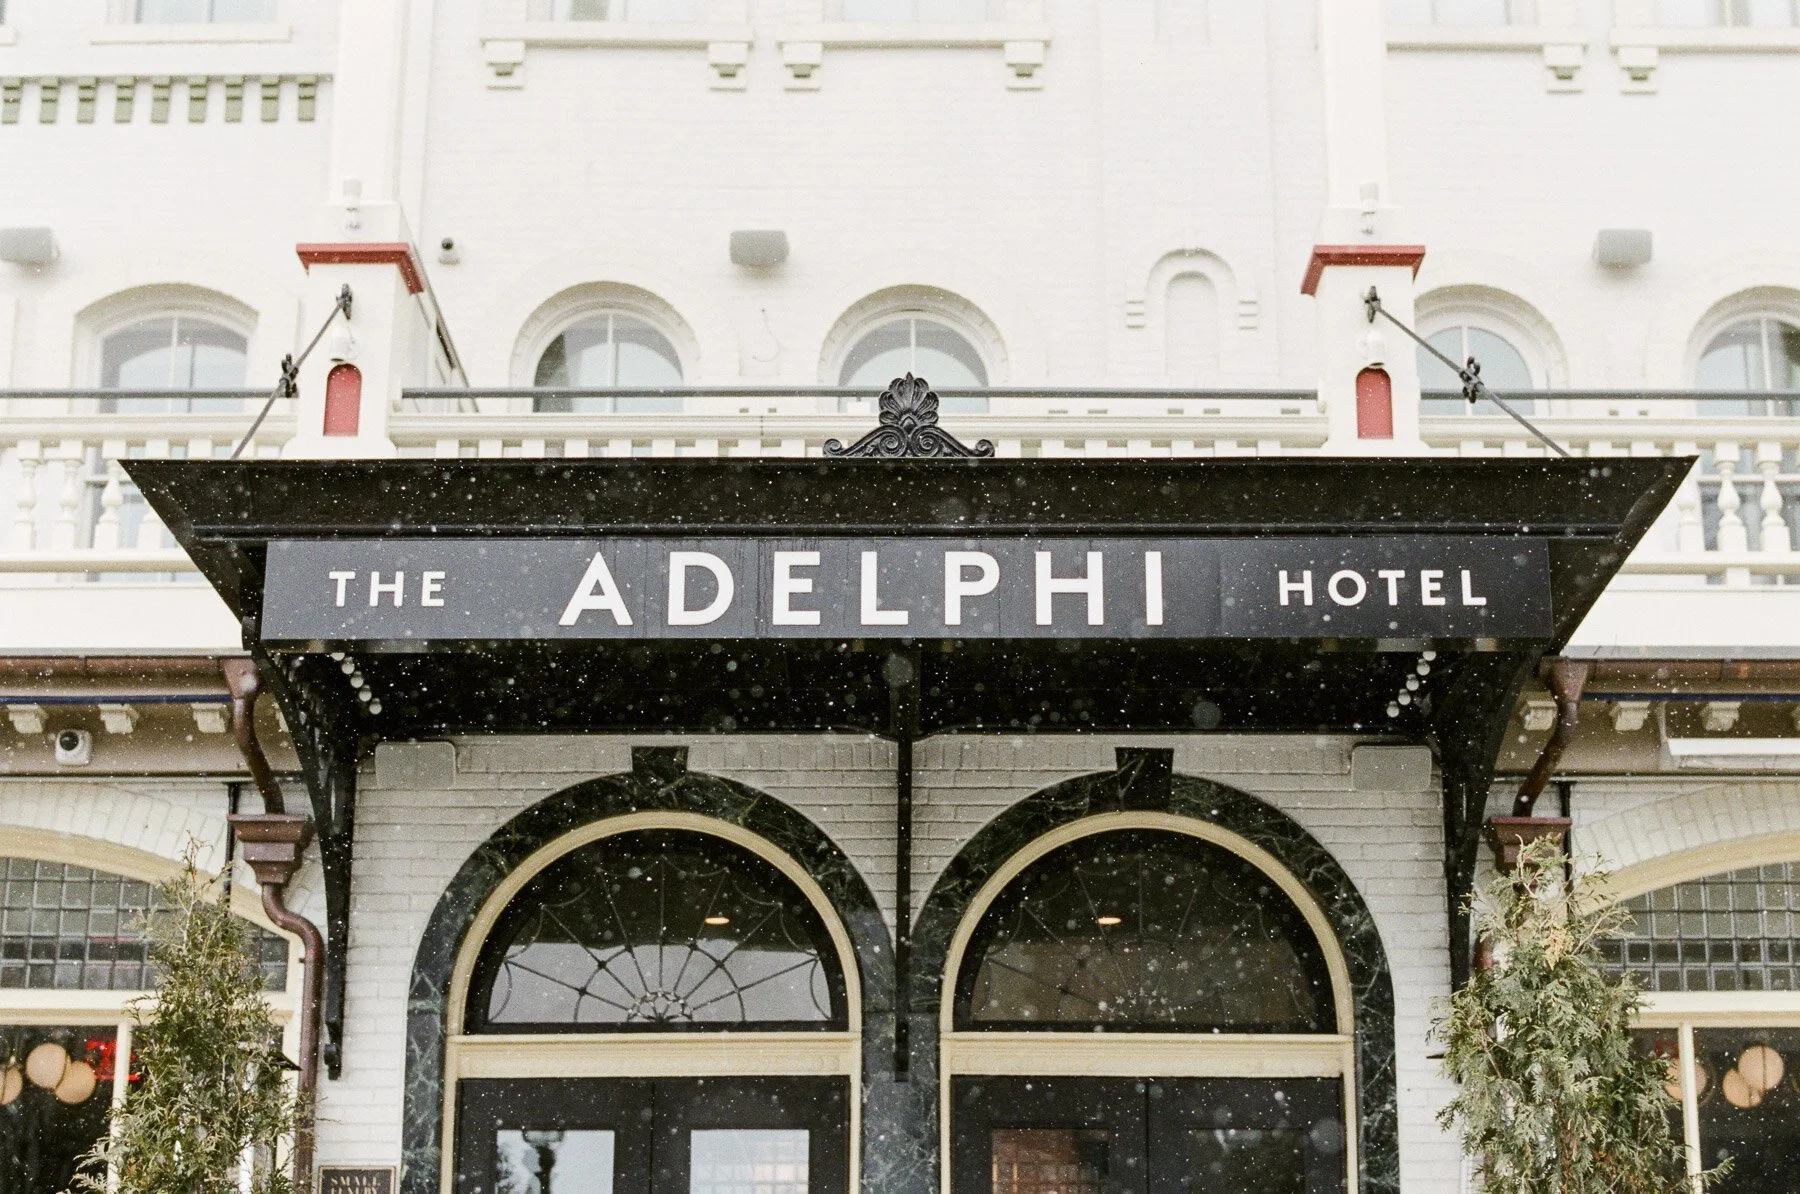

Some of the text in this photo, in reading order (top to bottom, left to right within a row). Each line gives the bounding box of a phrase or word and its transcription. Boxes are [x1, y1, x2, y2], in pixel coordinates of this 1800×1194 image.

[329, 551, 1487, 626] THE ADELPHI HOTEL
